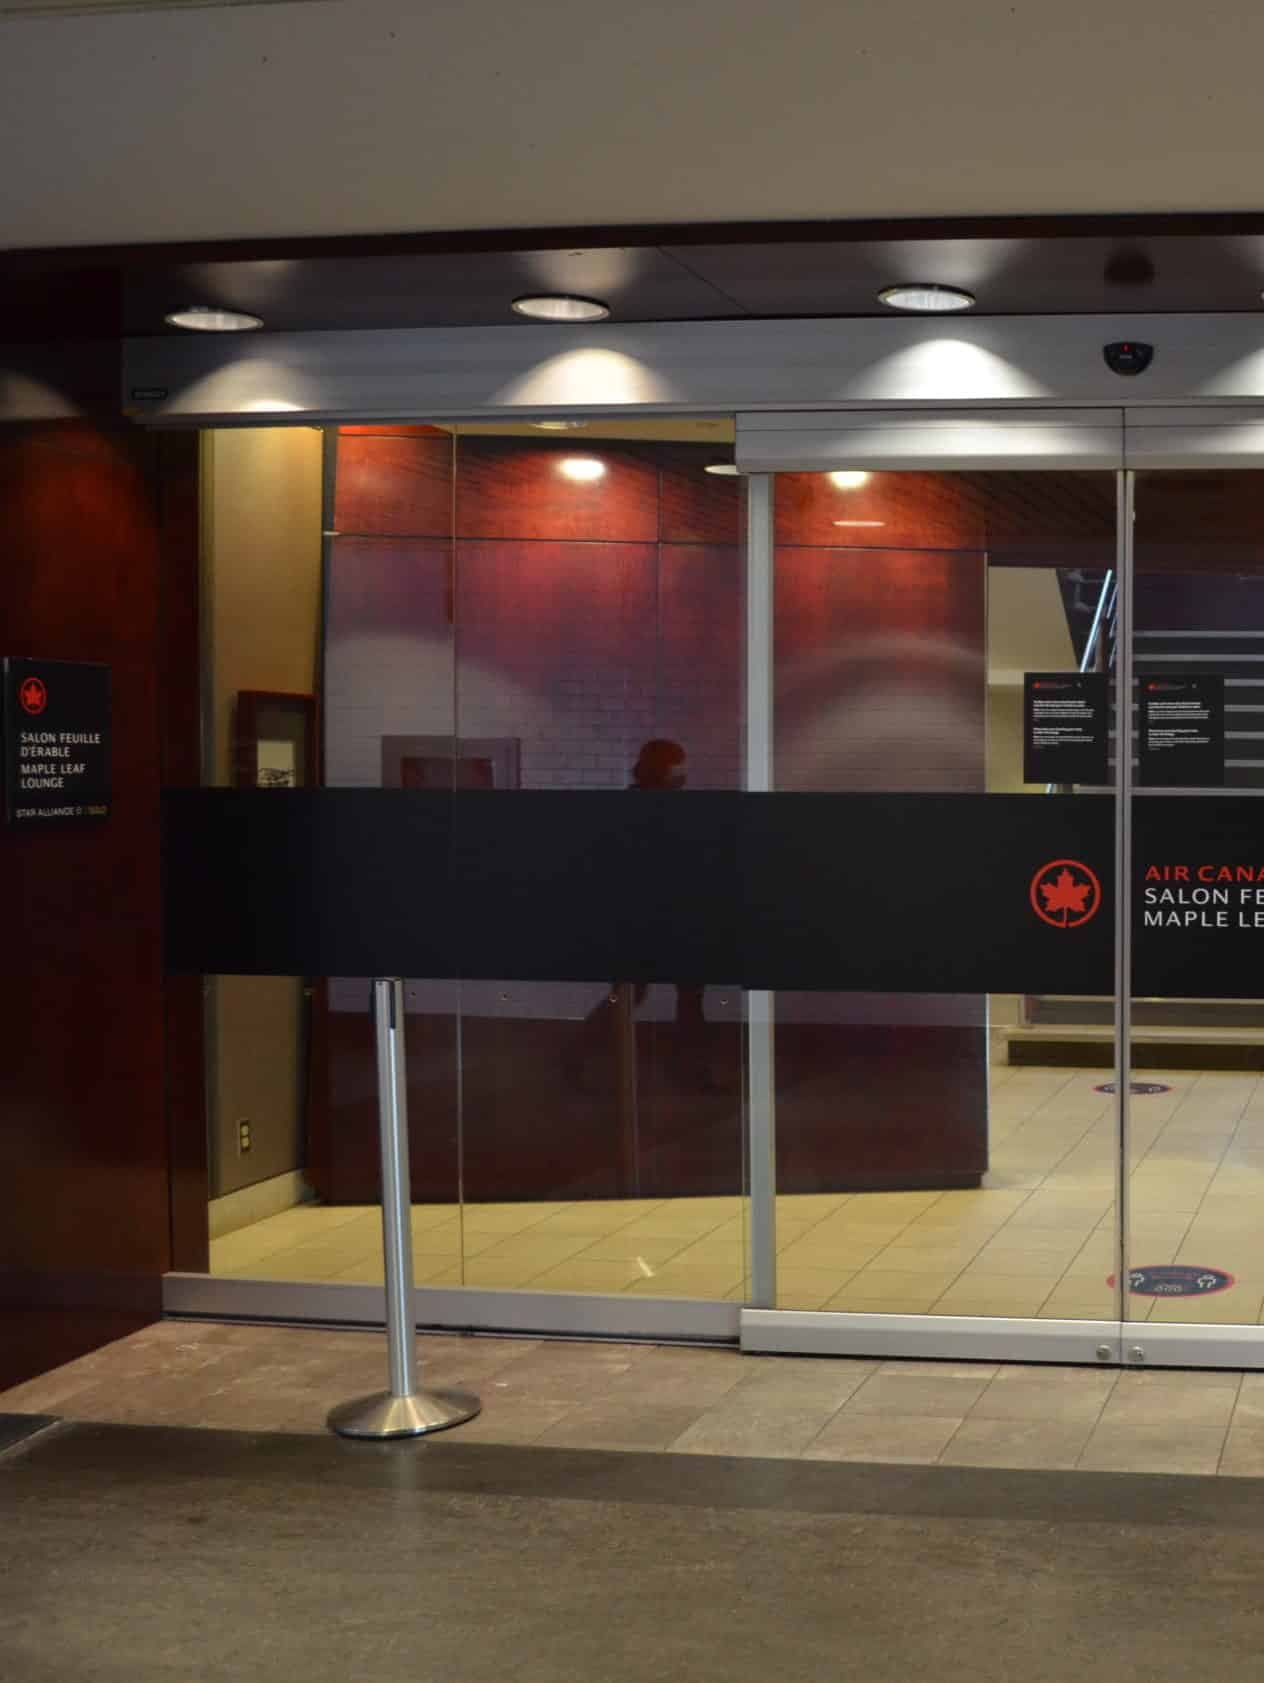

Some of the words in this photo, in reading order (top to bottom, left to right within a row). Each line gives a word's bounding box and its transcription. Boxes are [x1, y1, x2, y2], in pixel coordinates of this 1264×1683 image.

[19, 732, 57, 744] SALON
[59, 732, 101, 744] FEUILLE
[20, 763, 57, 774] MAPLE
[60, 763, 87, 774] LEAF
[20, 777, 64, 789] LOUNGE
[1145, 865, 1189, 881] AIR
[1144, 887, 1230, 906] SALON
[1144, 910, 1229, 928] MAPLE
